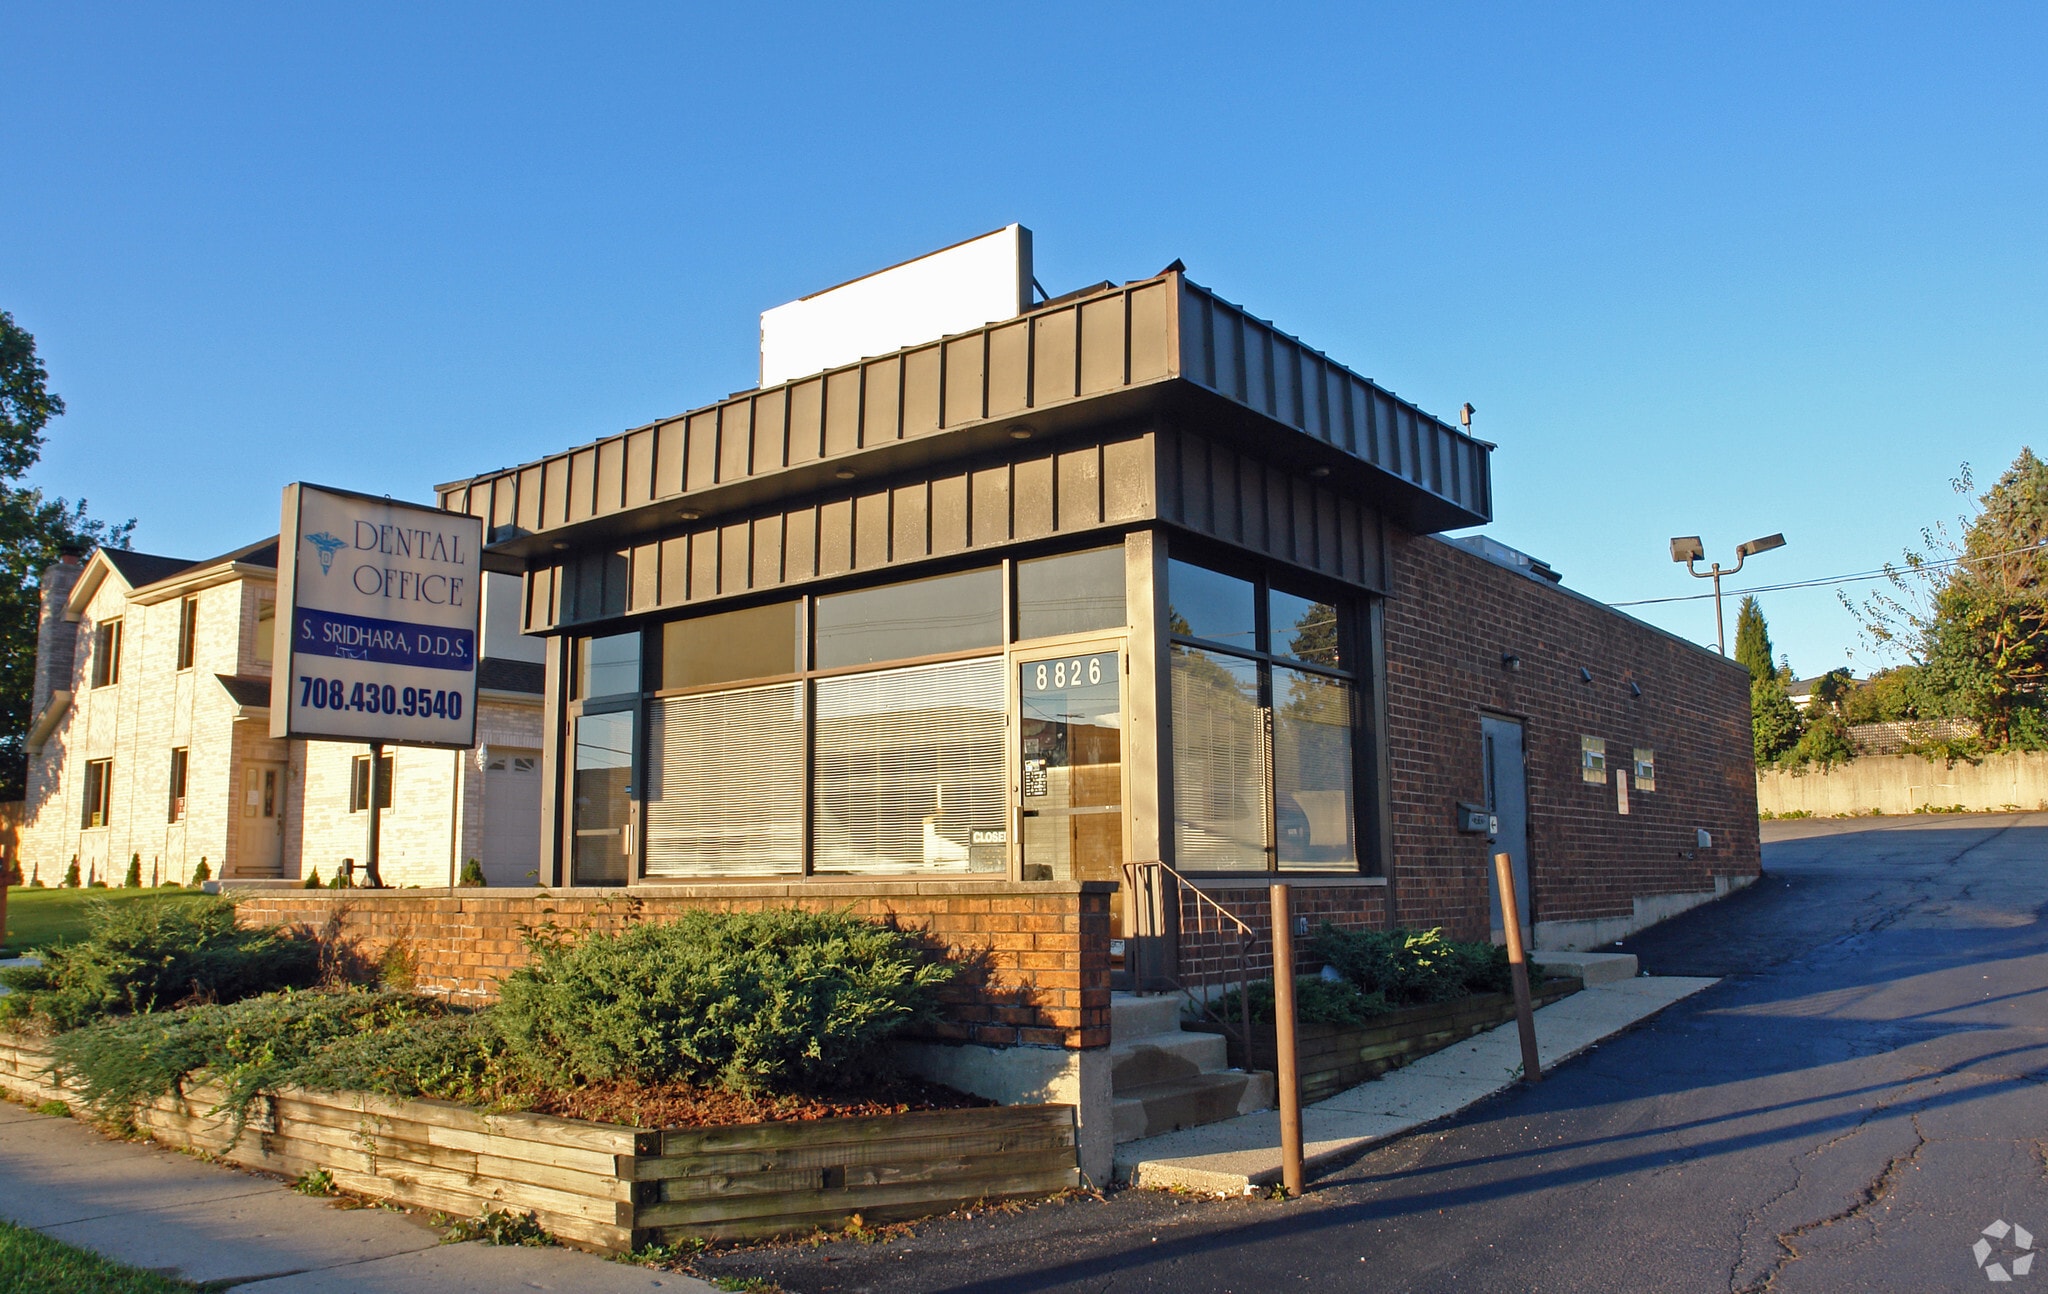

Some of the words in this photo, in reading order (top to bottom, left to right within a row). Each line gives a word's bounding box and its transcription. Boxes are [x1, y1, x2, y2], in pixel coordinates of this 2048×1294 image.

[354, 519, 465, 565] DENTAL
[353, 565, 464, 607] OFFICE
[302, 618, 315, 640] S.
[322, 622, 412, 655] SRIDHARA,
[418, 634, 469, 658] D.D.S.
[1035, 657, 1102, 691] 8826
[300, 676, 463, 721] 708.430.9540
